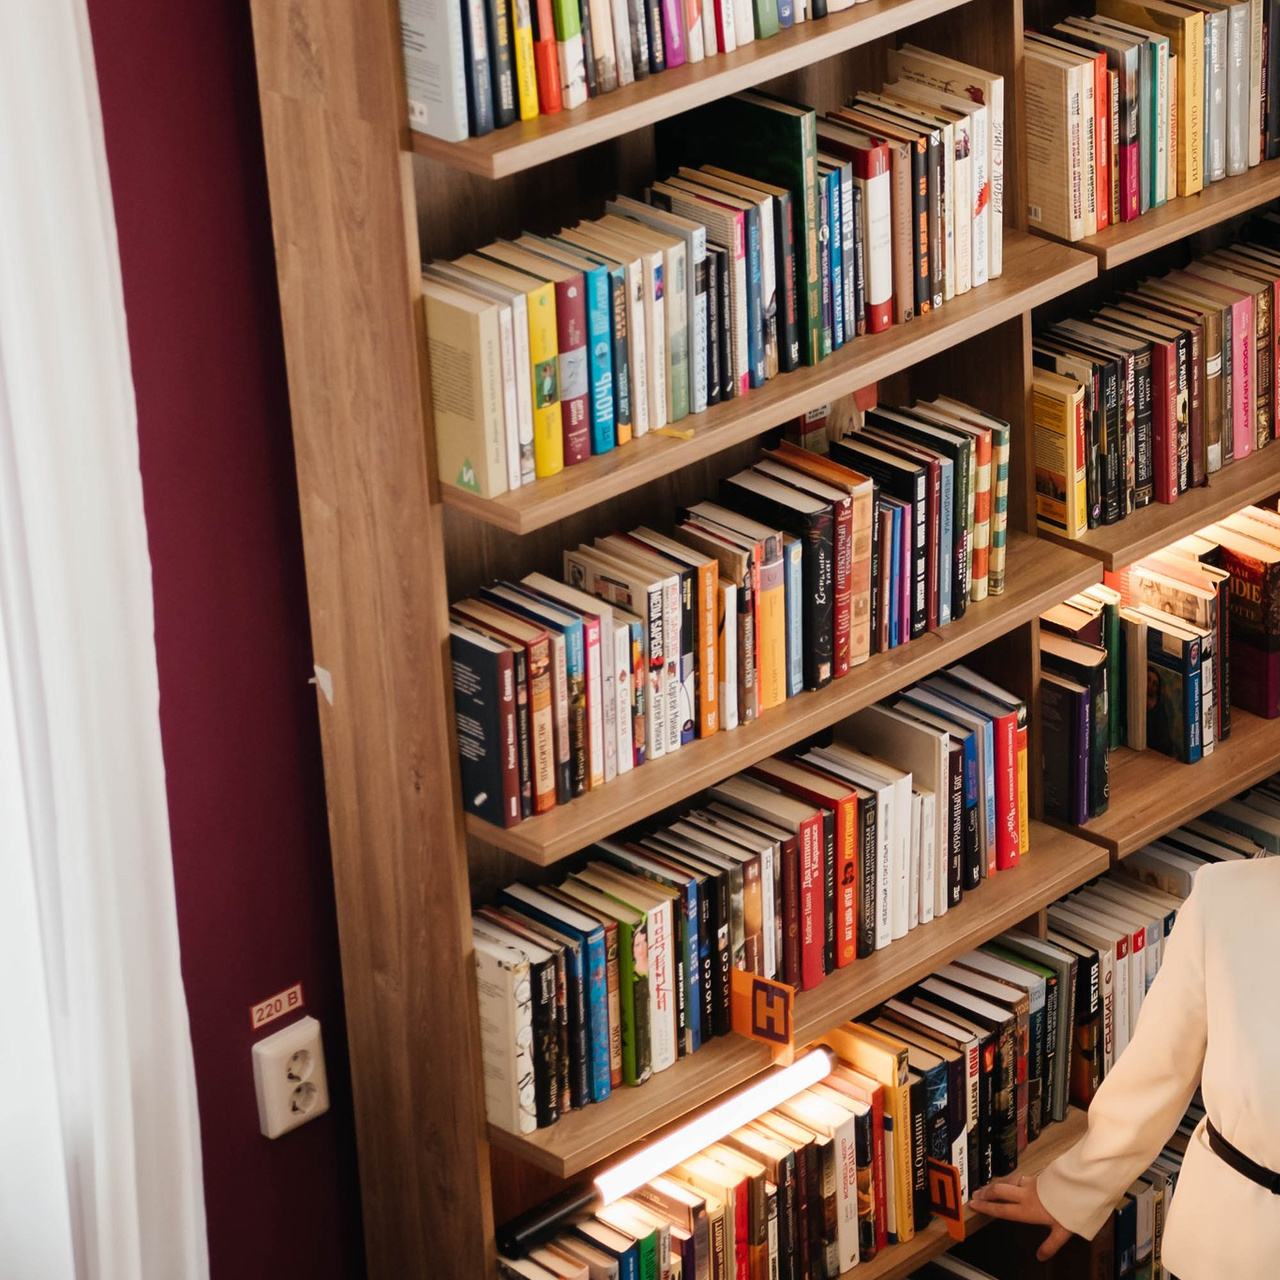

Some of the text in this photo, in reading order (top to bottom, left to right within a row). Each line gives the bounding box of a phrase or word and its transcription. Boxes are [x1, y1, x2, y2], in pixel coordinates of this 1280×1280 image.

[596, 371, 612, 423] НОЧЬ
[654, 588, 666, 656] MEDIA SAPIENS
[670, 584, 680, 654] MEDIA SAPIENS
[654, 694, 664, 750] Сергей Минаев
[670, 680, 680, 744] Сергей Минаев
[803, 869, 811, 886] Два
[256, 990, 298, 1023] 220 В
[1091, 964, 1099, 1013] ПЕТЛЯ
[679, 1012, 684, 1026] РЮ
[1105, 995, 1114, 1054] СЕНЧИН
[612, 1025, 620, 1057] МОЭМ
[970, 1046, 978, 1077] ПОНИ
[840, 1164, 848, 1198] ИСПОВЕДЬ
[846, 1144, 854, 1184] СЕРДЦА
[714, 1221, 723, 1252] ОЛКОТТ
